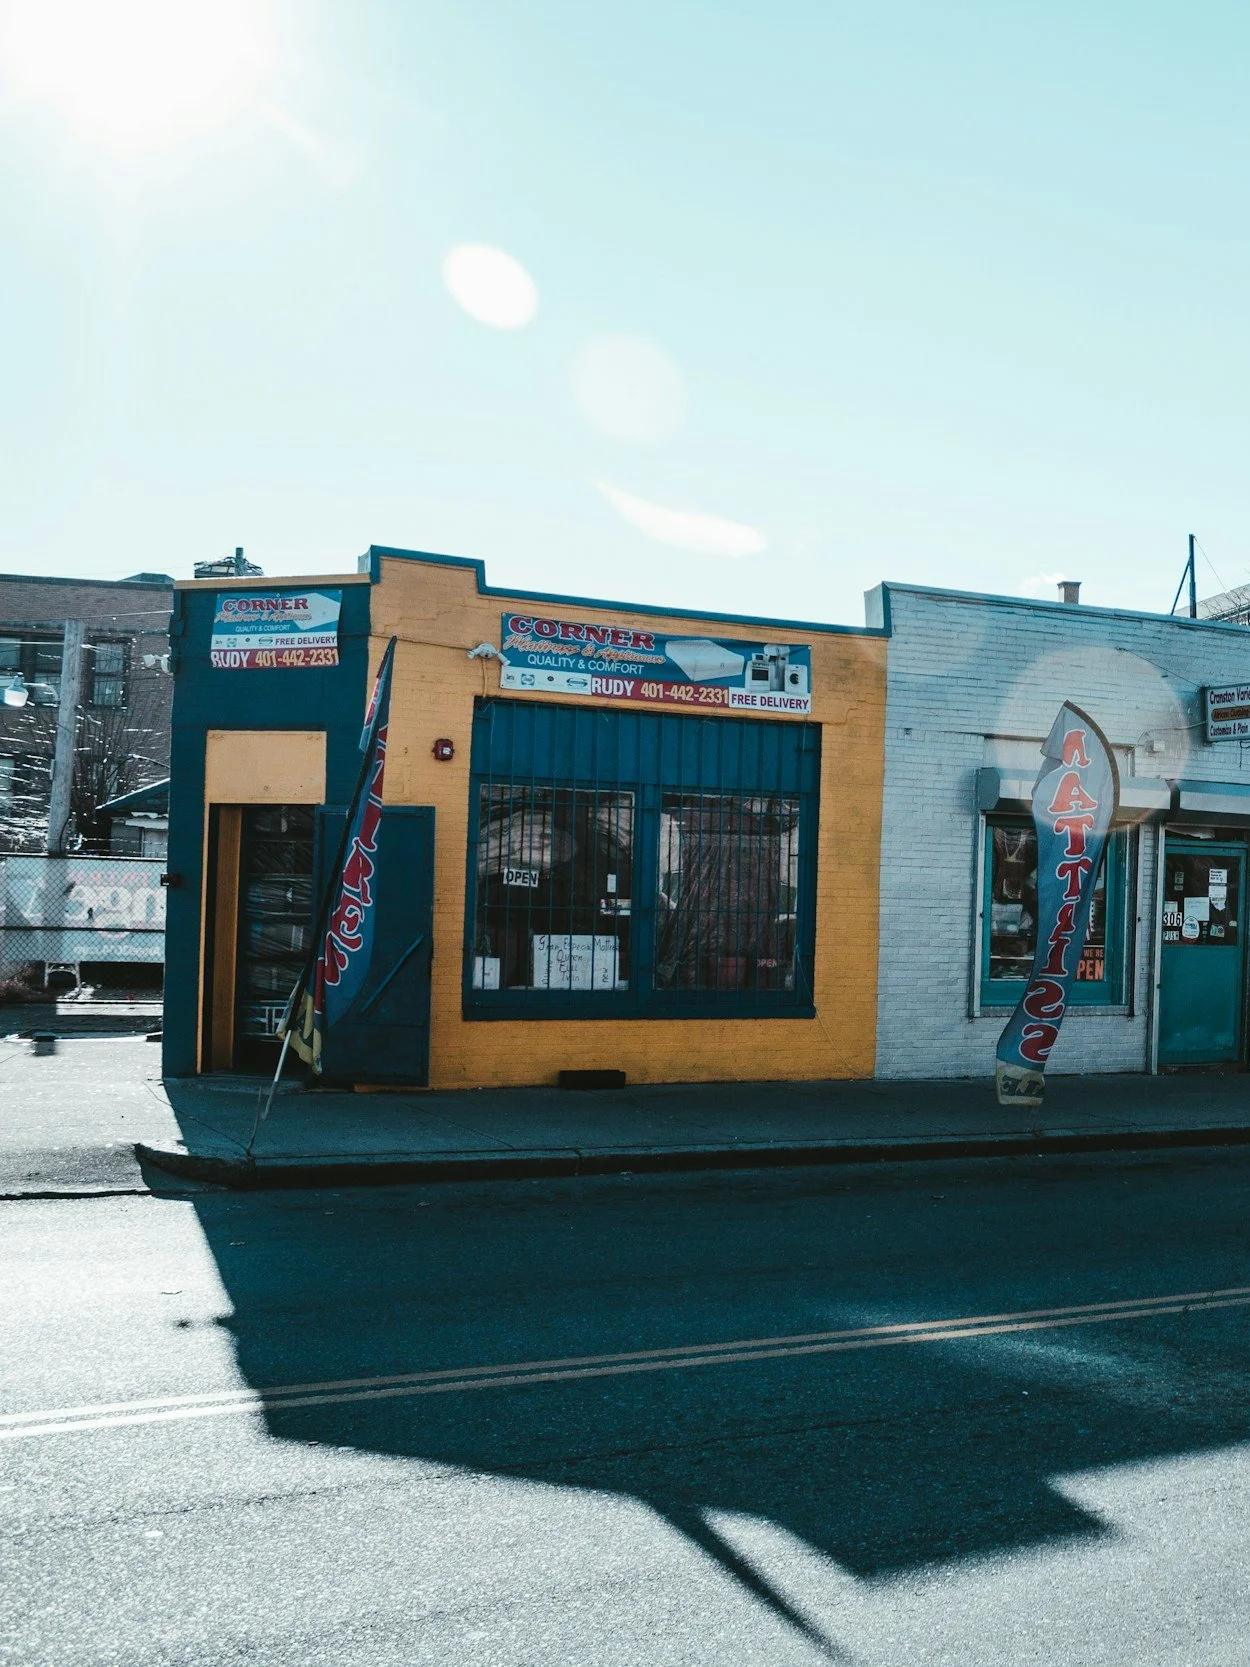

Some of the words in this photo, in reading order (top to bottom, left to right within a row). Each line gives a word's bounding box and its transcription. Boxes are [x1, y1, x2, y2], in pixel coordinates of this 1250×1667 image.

[222, 598, 309, 612] CORNER
[275, 637, 295, 645] FREE
[297, 636, 336, 645] DELIVERY
[509, 616, 655, 650] CORNER
[581, 643, 595, 656] &
[211, 651, 250, 668] RUDY
[255, 648, 339, 667] 401-442-2331
[527, 654, 575, 668] QUALITY
[578, 660, 585, 669] &
[588, 660, 644, 675] COMFORT
[592, 677, 634, 697] RUDY
[640, 681, 729, 704] 401-442-2331
[1210, 690, 1235, 704] Cranston
[731, 693, 757, 706] FREE
[760, 696, 809, 710] DELIVERY
[1237, 722, 1248, 734] Plain
[506, 869, 538, 885] OPEN
[1163, 912, 1182, 927] 306
[1076, 959, 1104, 980] PEN
